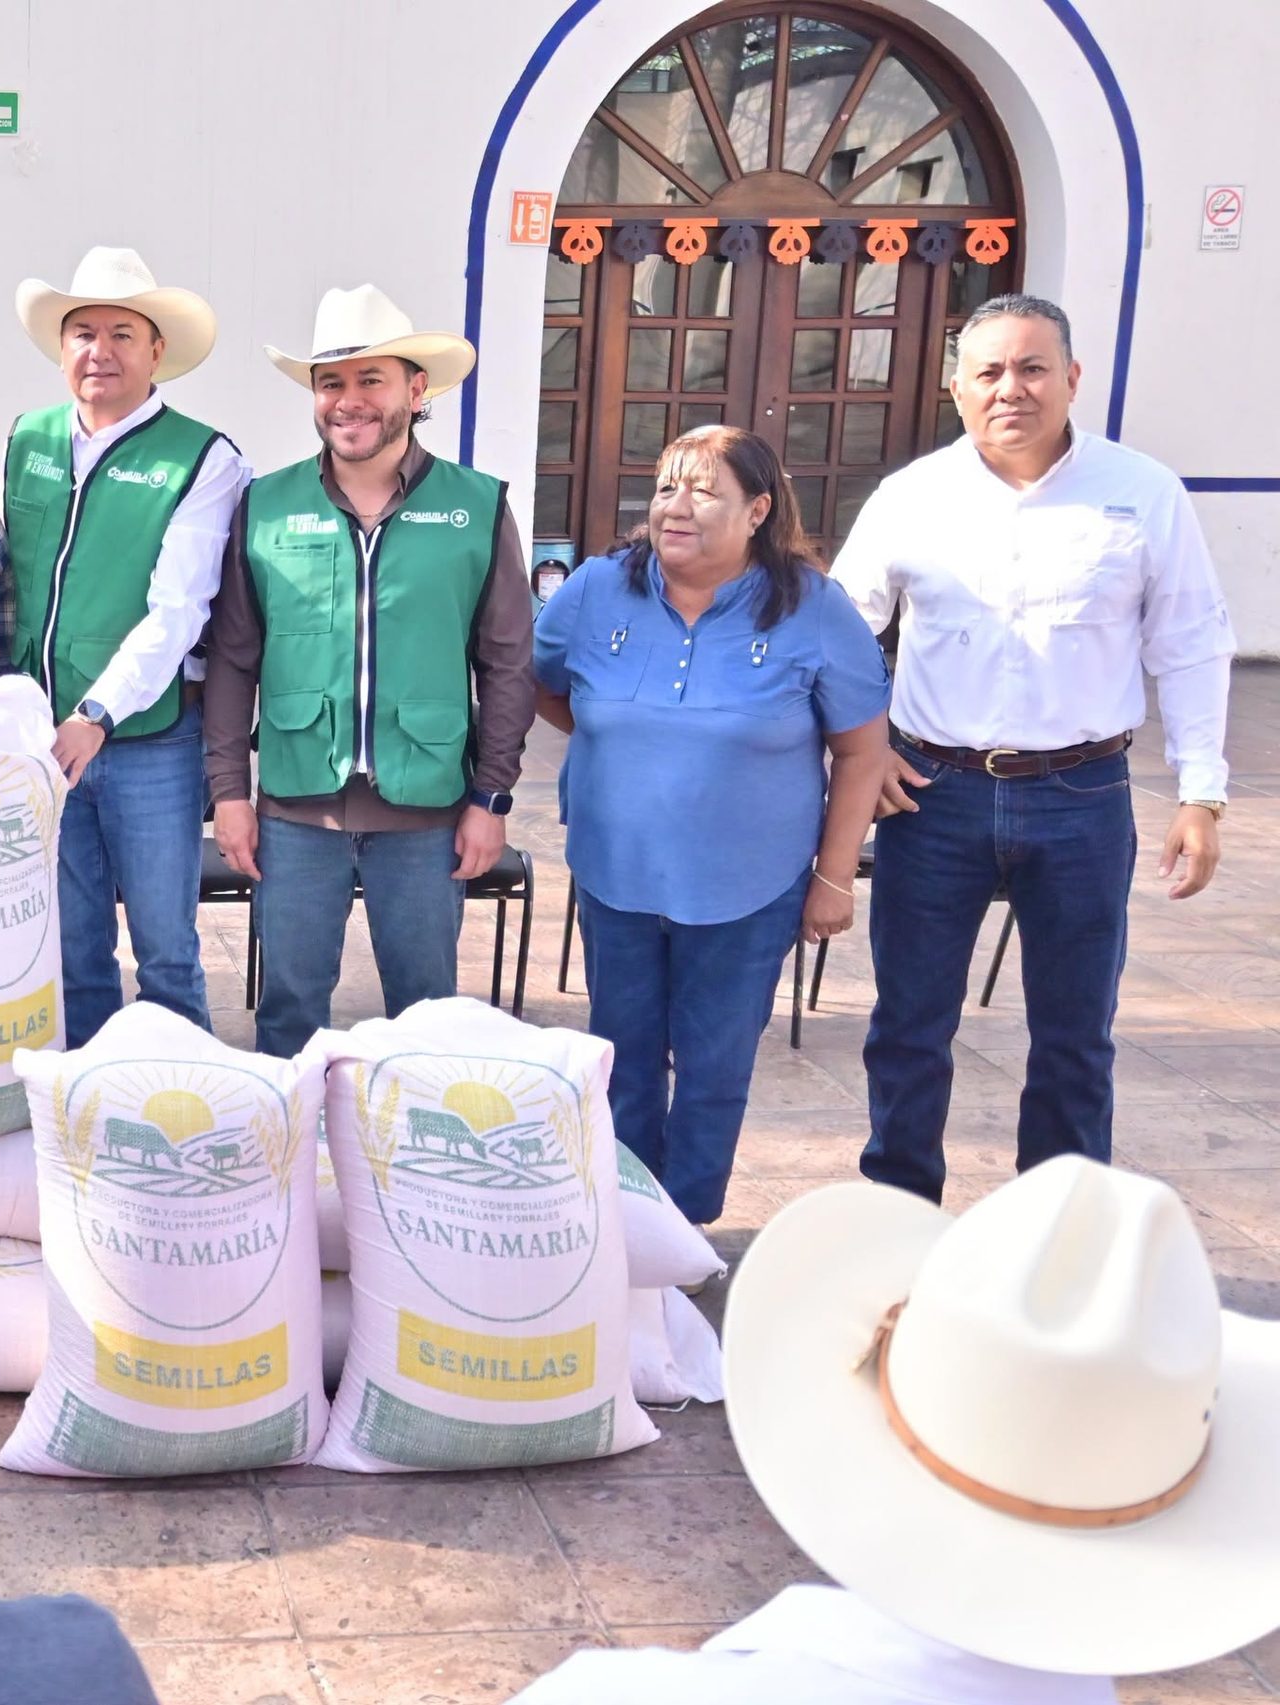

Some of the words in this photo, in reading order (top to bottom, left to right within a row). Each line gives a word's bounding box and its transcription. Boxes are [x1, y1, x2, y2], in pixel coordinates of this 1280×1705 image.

[400, 511, 449, 522] COAHUILA
[172, 1191, 272, 1219] COMERCIALIZADORA
[394, 1178, 468, 1205] PRODUCTORA
[480, 1191, 581, 1211] COMERCIALIZADORA
[425, 1199, 441, 1211] DE
[506, 1211, 560, 1223] FORRAJES
[197, 1212, 249, 1231] FORRAJES
[397, 1209, 590, 1259] SANTAMARÍA
[91, 1218, 278, 1267] SANTAMARÍA
[114, 1351, 272, 1390] SEMILLAS
[419, 1340, 580, 1382] SEMILLAS
